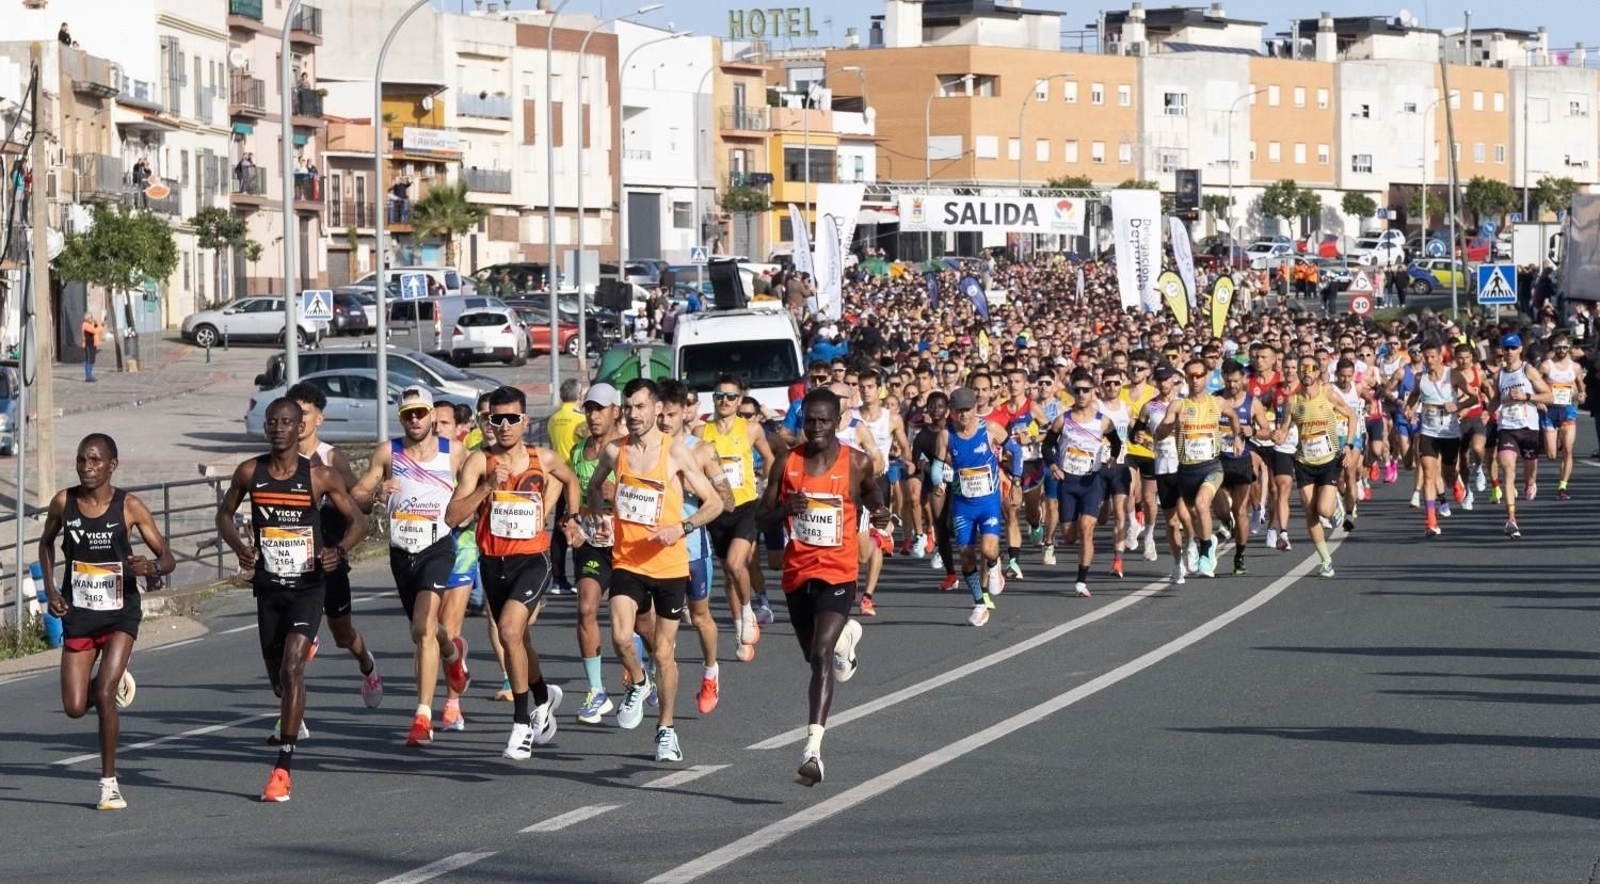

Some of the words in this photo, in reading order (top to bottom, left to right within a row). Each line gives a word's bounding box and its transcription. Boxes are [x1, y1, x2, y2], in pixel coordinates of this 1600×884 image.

[729, 7, 818, 39] HOTEL
[944, 202, 1039, 226] SALIDA
[1355, 301, 1368, 309] 30
[494, 508, 534, 516] BENABBOU
[631, 505, 637, 513] 9
[275, 510, 303, 518] VICKY
[399, 525, 424, 533] CABILA
[802, 527, 822, 537] 2163
[262, 540, 306, 548] NZANBIMA
[405, 537, 418, 545] 737
[73, 579, 114, 589] WANJIRU
[85, 594, 103, 602] 2162
